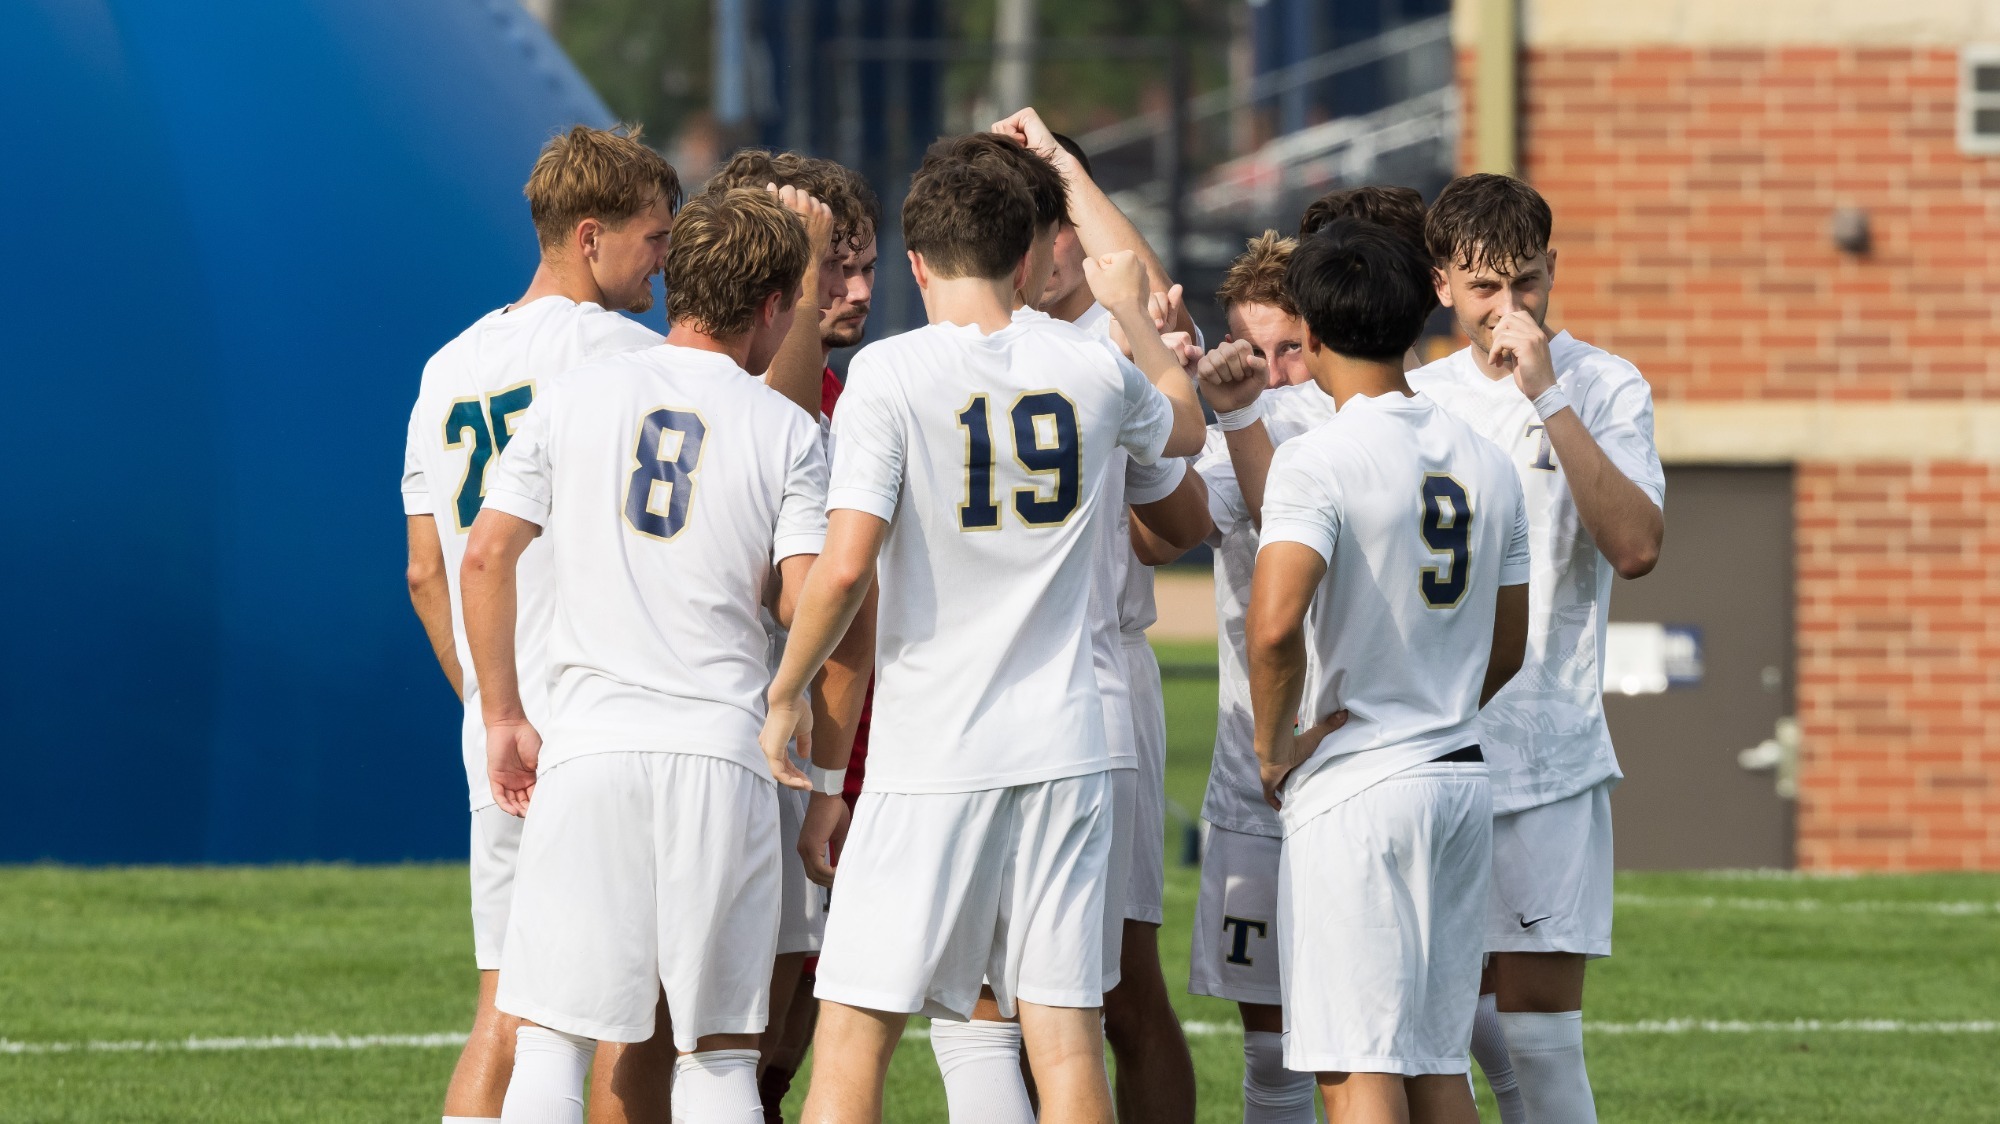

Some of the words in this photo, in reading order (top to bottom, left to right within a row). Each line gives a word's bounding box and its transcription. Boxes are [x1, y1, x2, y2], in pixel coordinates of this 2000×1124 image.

[622, 404, 711, 544] 8
[954, 388, 1083, 532] 19
[1524, 423, 1558, 473] T
[1419, 472, 1474, 609] 9
[1223, 914, 1267, 967] T
